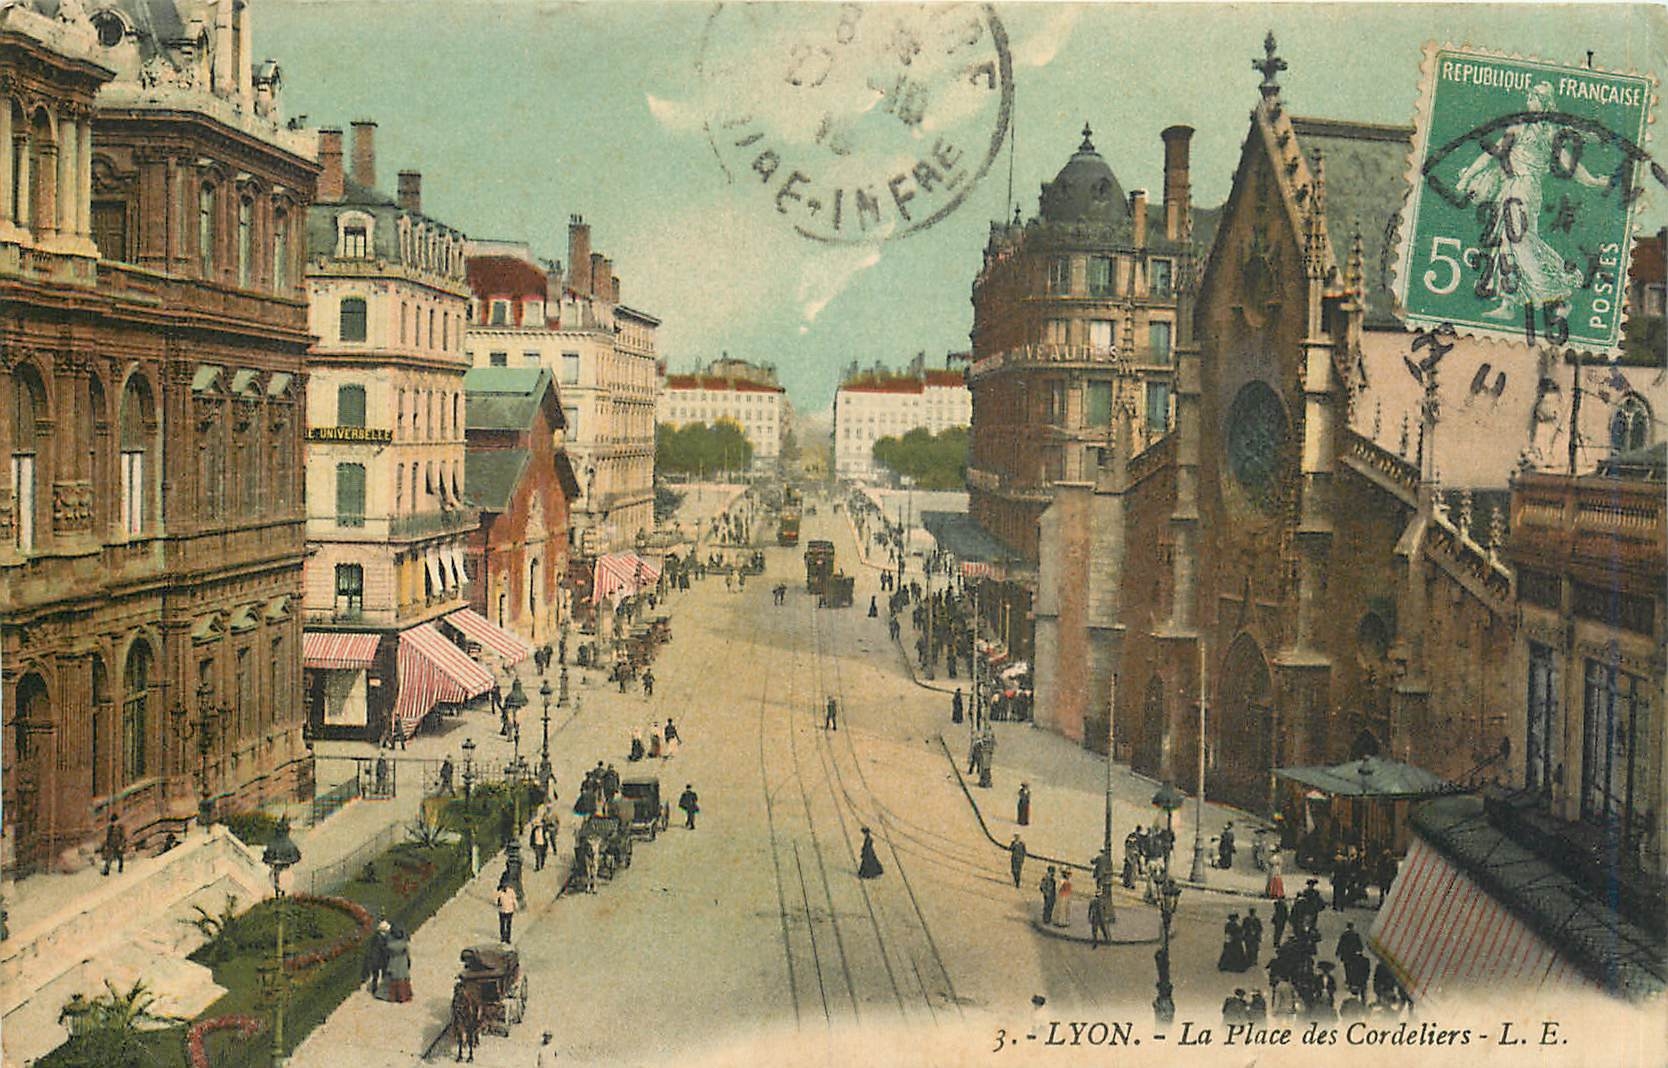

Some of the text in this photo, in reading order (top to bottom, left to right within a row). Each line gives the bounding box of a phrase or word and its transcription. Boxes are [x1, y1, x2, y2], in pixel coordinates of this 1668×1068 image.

[1442, 61, 1641, 107] REPUBLIQUE FRANÇAISE
[1589, 242, 1620, 330] POSTES
